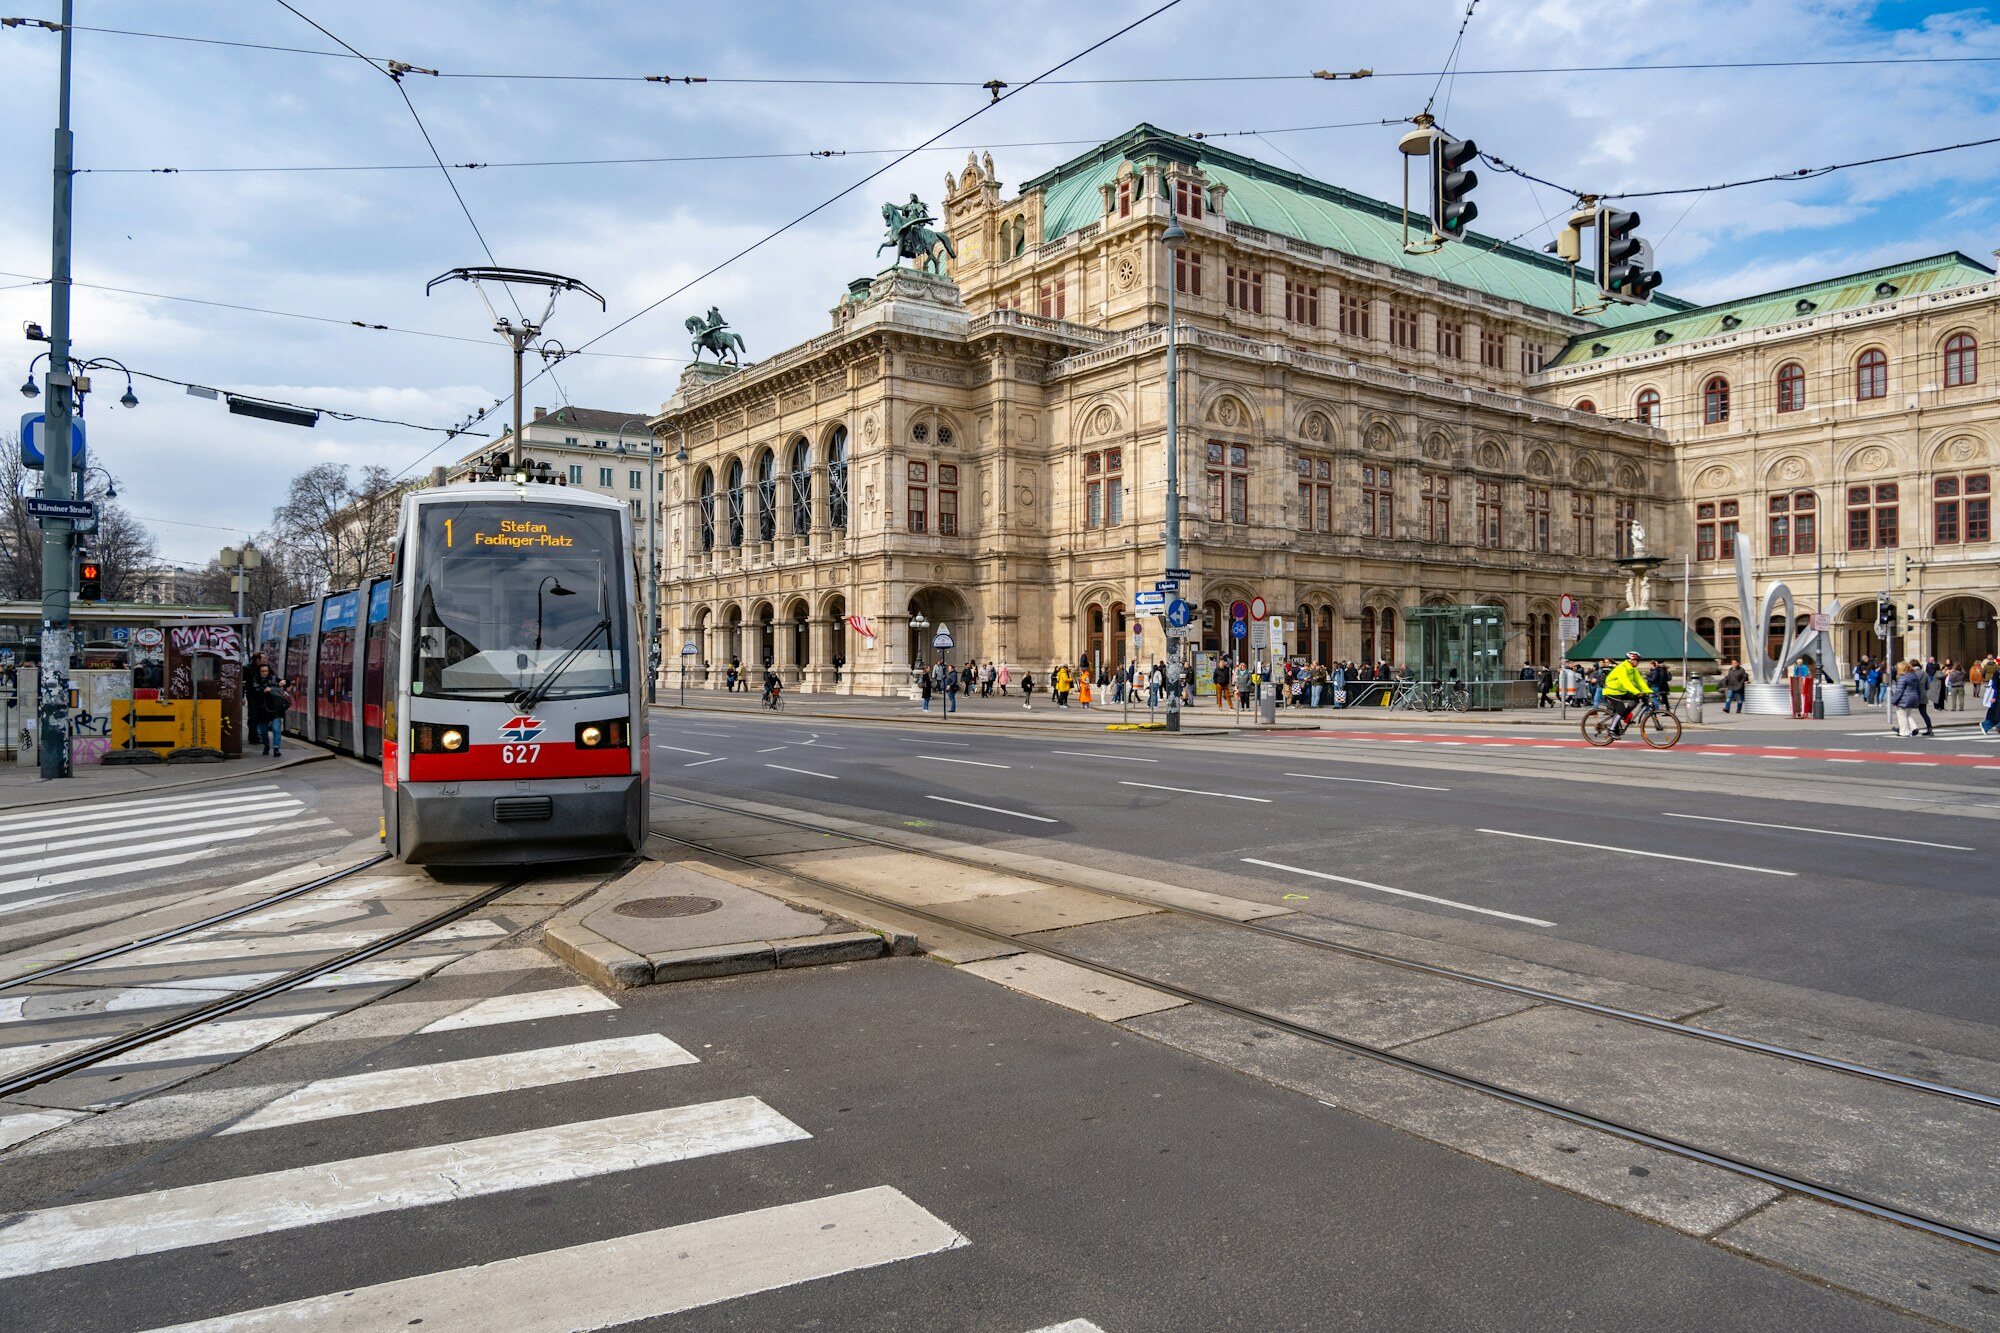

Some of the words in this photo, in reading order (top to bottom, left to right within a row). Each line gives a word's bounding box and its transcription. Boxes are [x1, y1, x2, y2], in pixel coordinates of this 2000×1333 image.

[37, 503, 69, 513] Kärntner
[69, 505, 91, 514] Straße
[444, 519, 453, 548] 1
[501, 520, 547, 533] Stefan
[475, 533, 573, 548] Fadinger-Platz
[502, 744, 541, 764] 627
